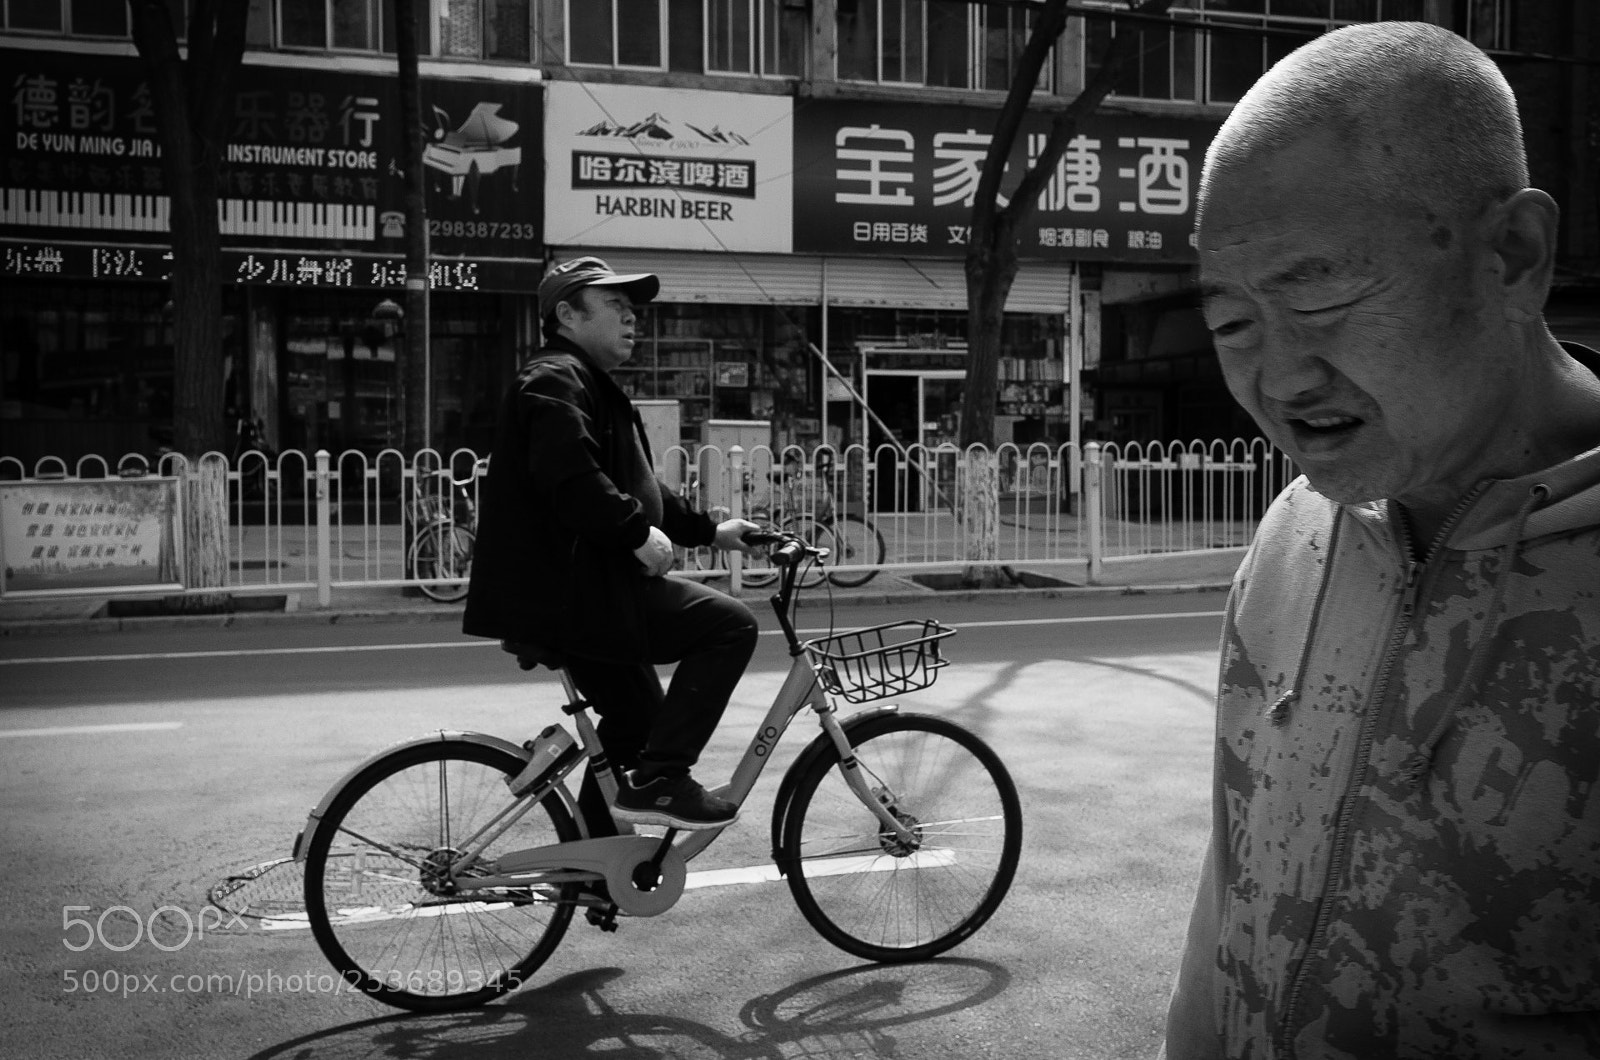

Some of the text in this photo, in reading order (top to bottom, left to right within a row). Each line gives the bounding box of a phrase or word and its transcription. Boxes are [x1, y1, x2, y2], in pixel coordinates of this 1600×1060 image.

[16, 132, 38, 150] DE
[42, 134, 76, 152] YUN
[79, 137, 125, 155] MING
[128, 139, 153, 157] JIA
[227, 144, 377, 170] INSTRUMENT STORE
[578, 155, 750, 189] 哈尔滨啤酒
[596, 194, 734, 221] HARBIN BEER
[854, 221, 928, 244] 日用百货
[754, 726, 778, 757] ofo
